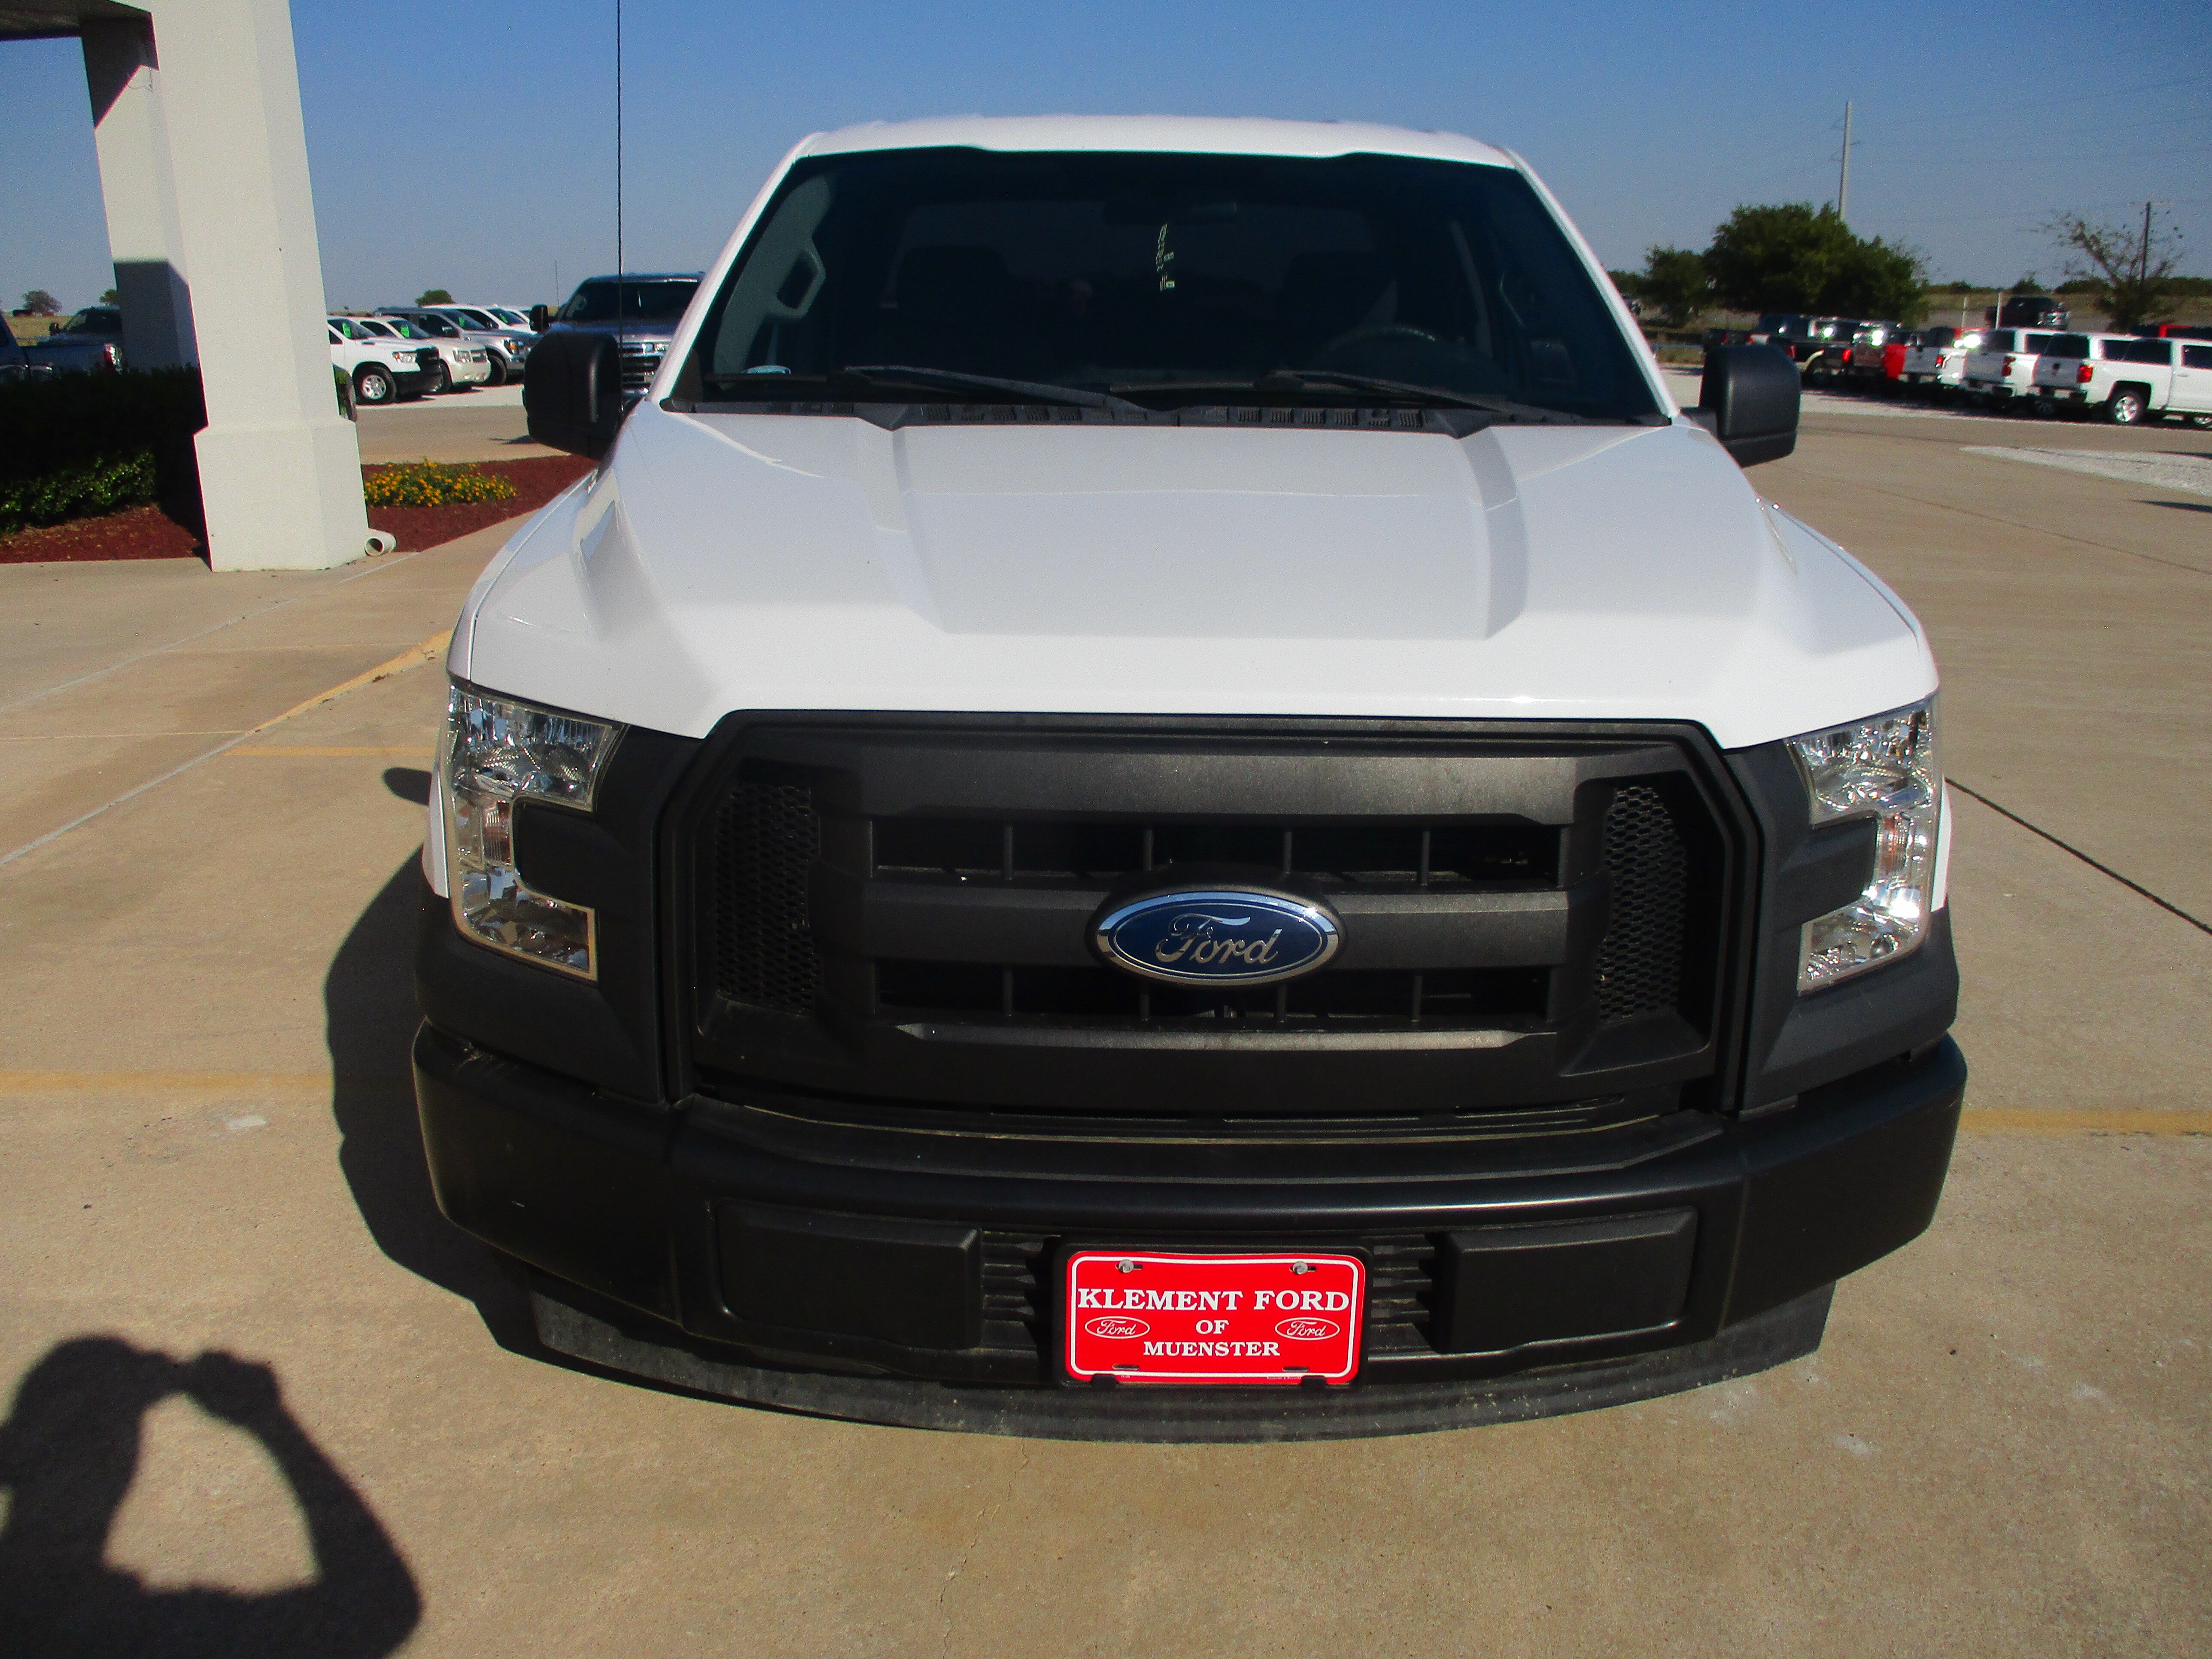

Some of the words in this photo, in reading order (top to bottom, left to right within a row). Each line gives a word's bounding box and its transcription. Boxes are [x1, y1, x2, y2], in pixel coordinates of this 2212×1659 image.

[1155, 913, 1282, 964] Ford
[1078, 1288, 1243, 1311] KLEMENT
[1253, 1289, 1349, 1311] FORD
[1096, 1319, 1137, 1335] Ford
[1195, 1319, 1229, 1334] OF
[1286, 1320, 1327, 1337] Ford
[1143, 1341, 1280, 1357] MUENSTER
